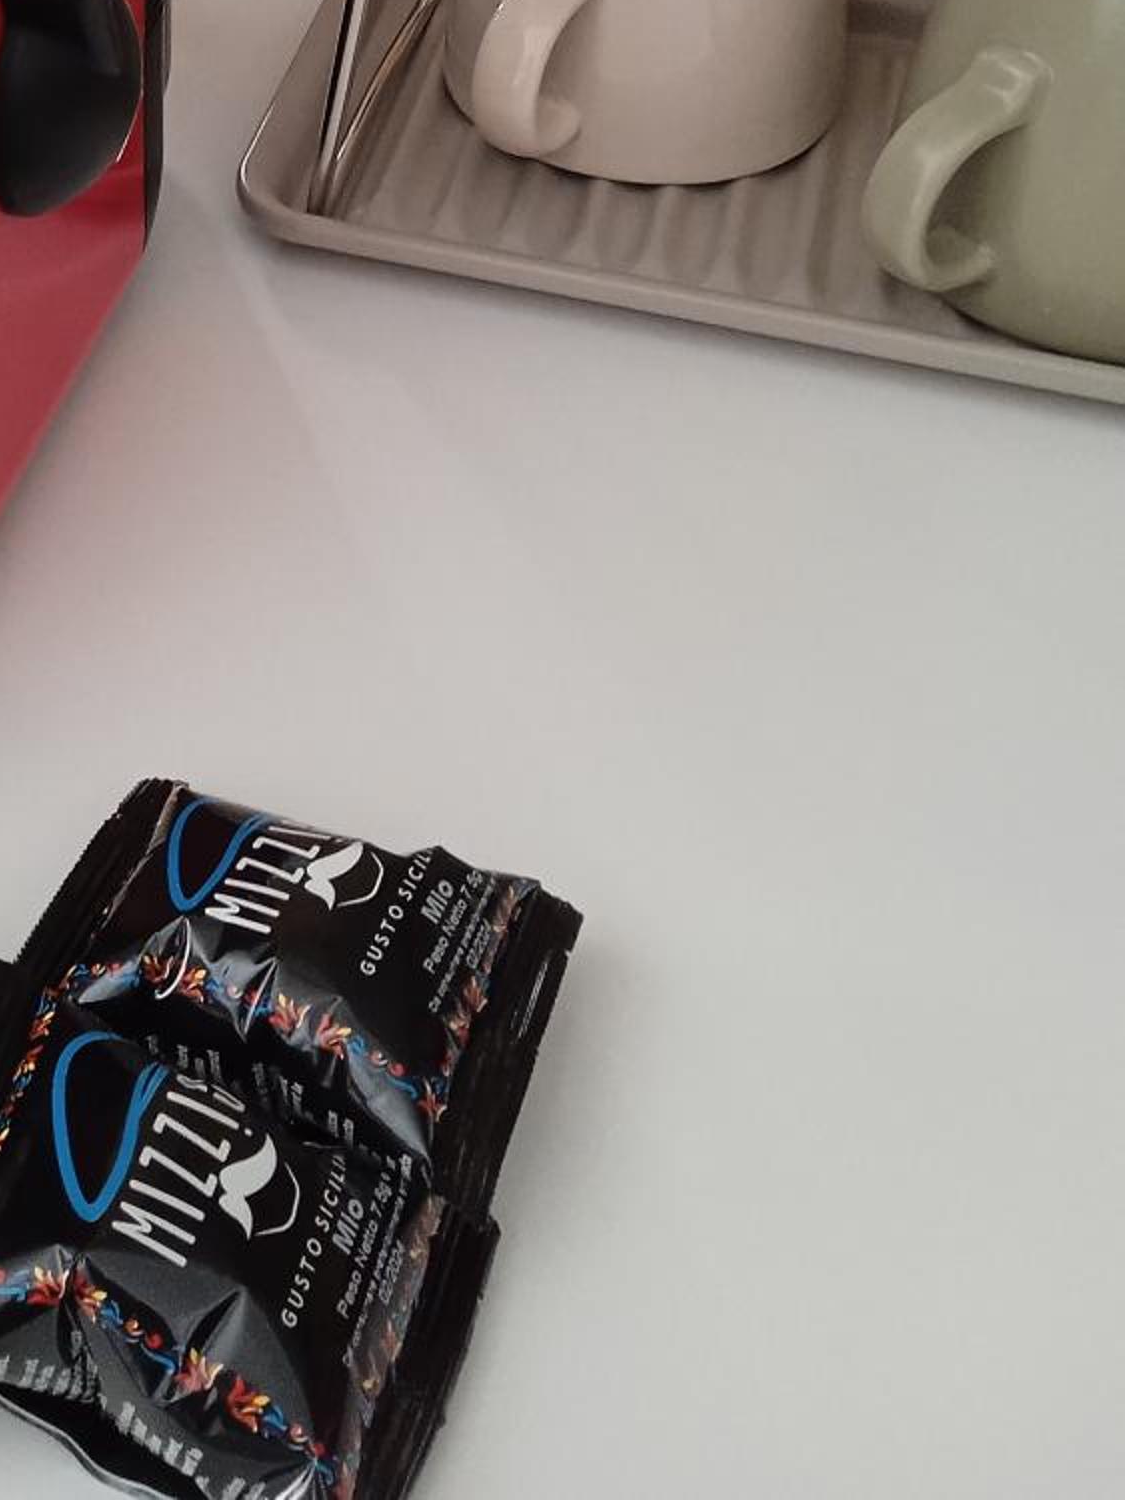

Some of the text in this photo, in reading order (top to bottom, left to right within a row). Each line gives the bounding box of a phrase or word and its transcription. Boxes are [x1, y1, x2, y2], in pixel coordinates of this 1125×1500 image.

[205, 821, 343, 934] MIZZI
[360, 904, 405, 977] GUSTO
[423, 936, 450, 975] Peso
[442, 899, 469, 938] Netto
[280, 1237, 323, 1329] GUSTO
[335, 1270, 363, 1320] Peso
[354, 1221, 379, 1269] Netto
